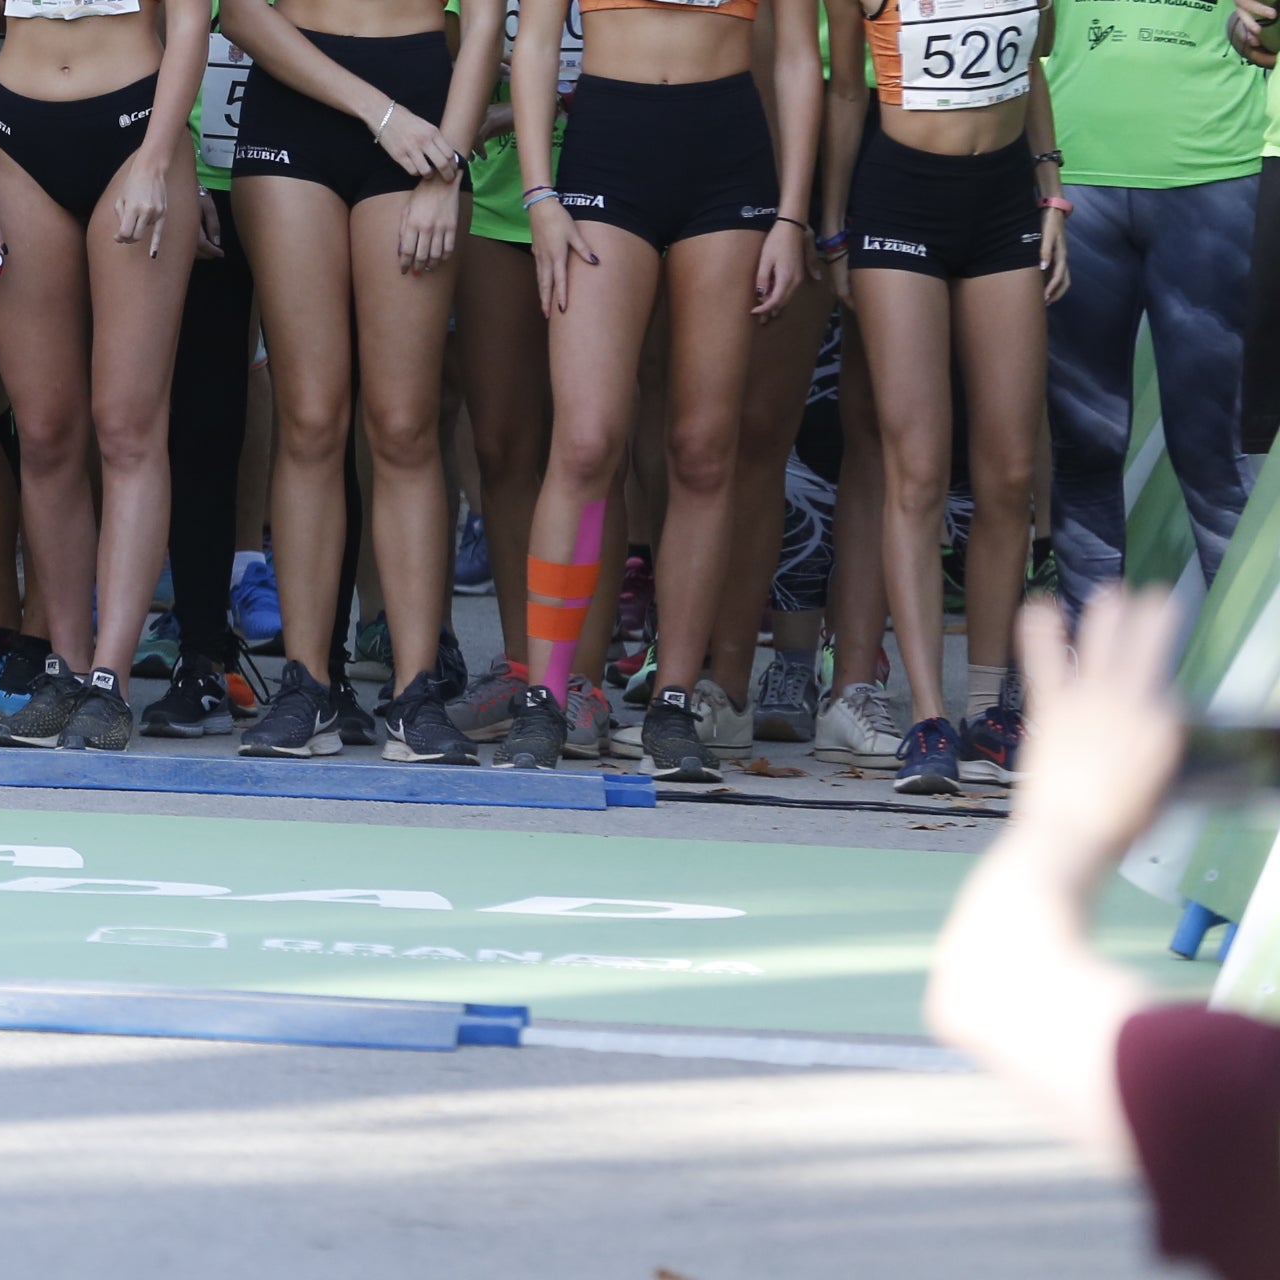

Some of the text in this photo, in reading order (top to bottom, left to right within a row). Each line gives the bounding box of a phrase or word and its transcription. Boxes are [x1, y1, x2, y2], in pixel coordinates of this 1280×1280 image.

[922, 25, 1022, 79] 526
[863, 235, 926, 257] LA ZUBIA
[95, 674, 112, 684] NIKE
